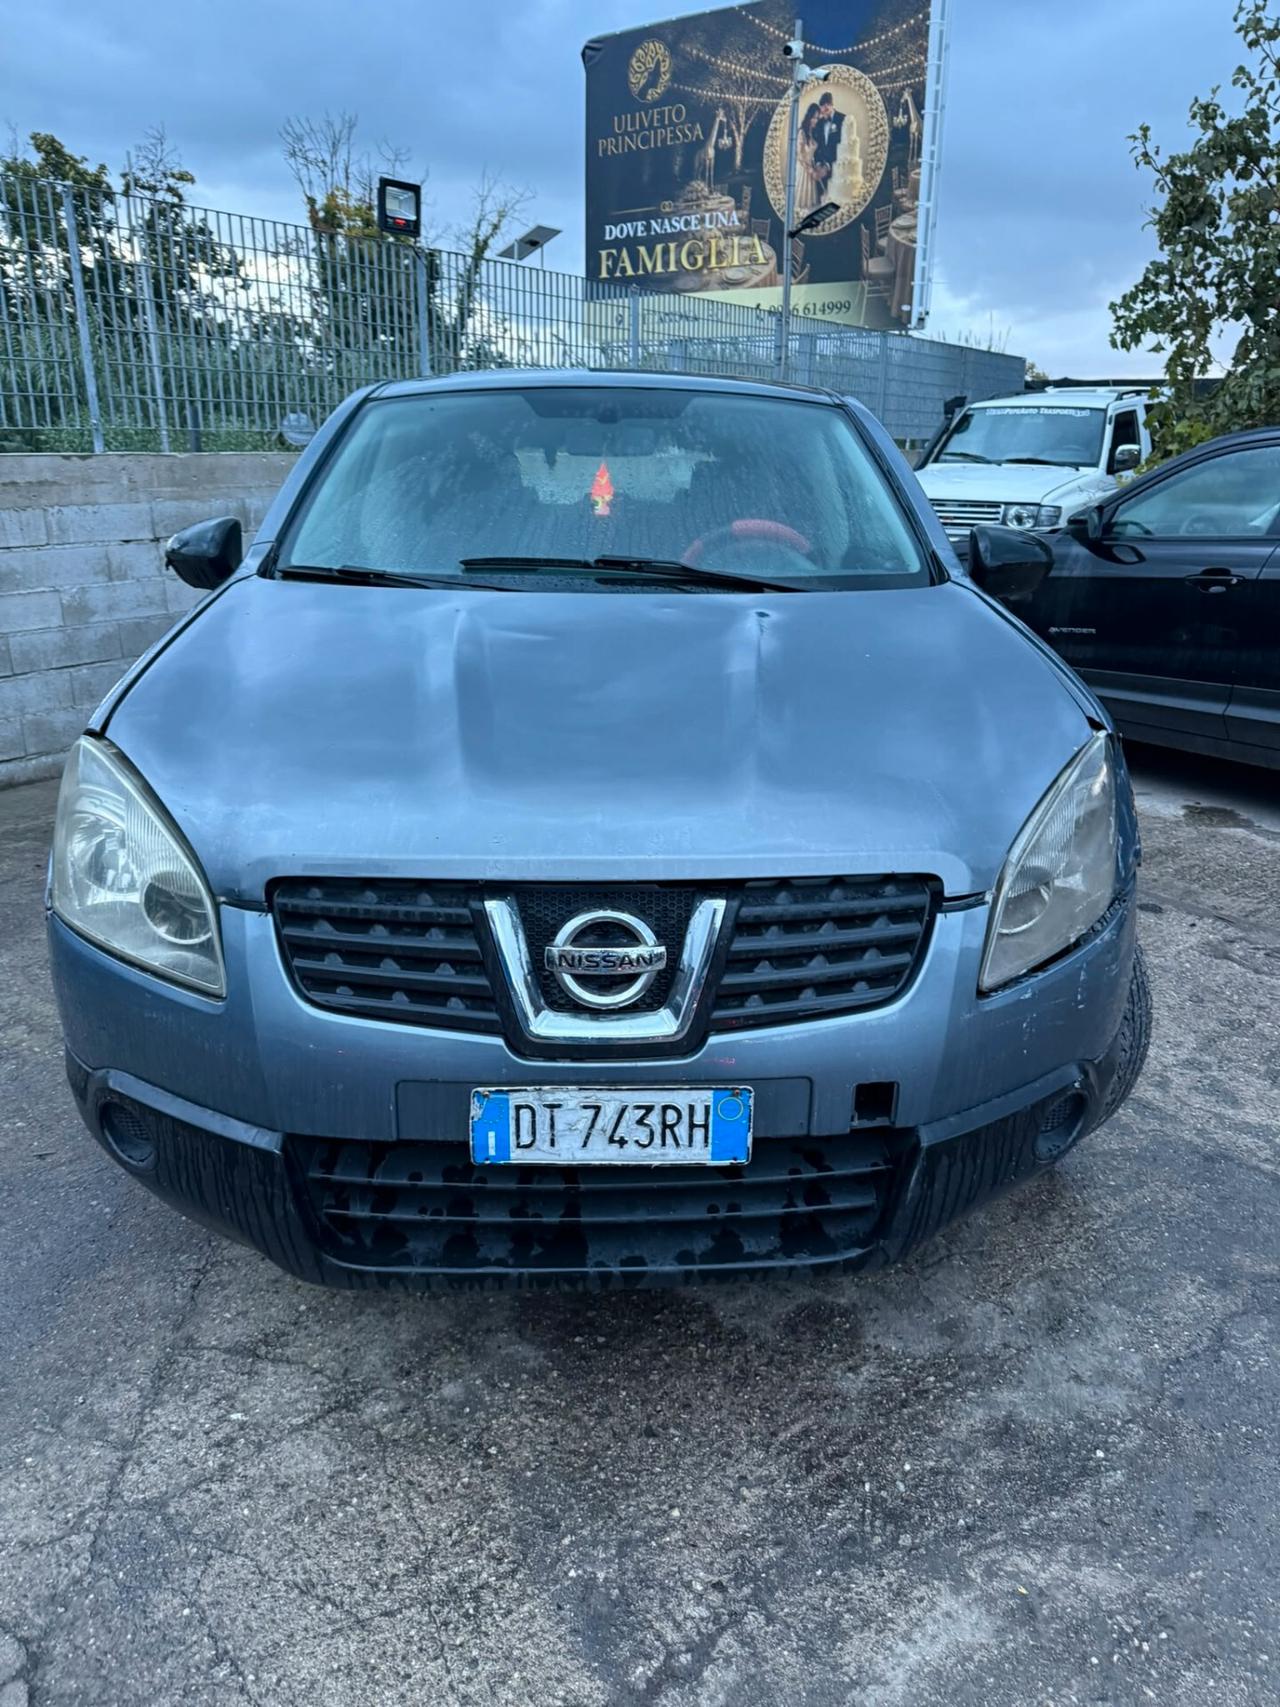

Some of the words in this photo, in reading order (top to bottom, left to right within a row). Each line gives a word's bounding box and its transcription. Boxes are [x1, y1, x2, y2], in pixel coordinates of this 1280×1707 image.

[613, 103, 686, 134] ULIVETO
[598, 122, 704, 157] PRINCIPESSA
[604, 220, 647, 241] DOVE
[650, 214, 701, 235] NASCE
[704, 210, 741, 229] UNA
[598, 233, 769, 279] FAMIGLIA
[802, 299, 851, 316] 614999
[558, 952, 654, 969] NISSAN
[514, 1103, 562, 1149] DT
[581, 1103, 712, 1149] 743RH
